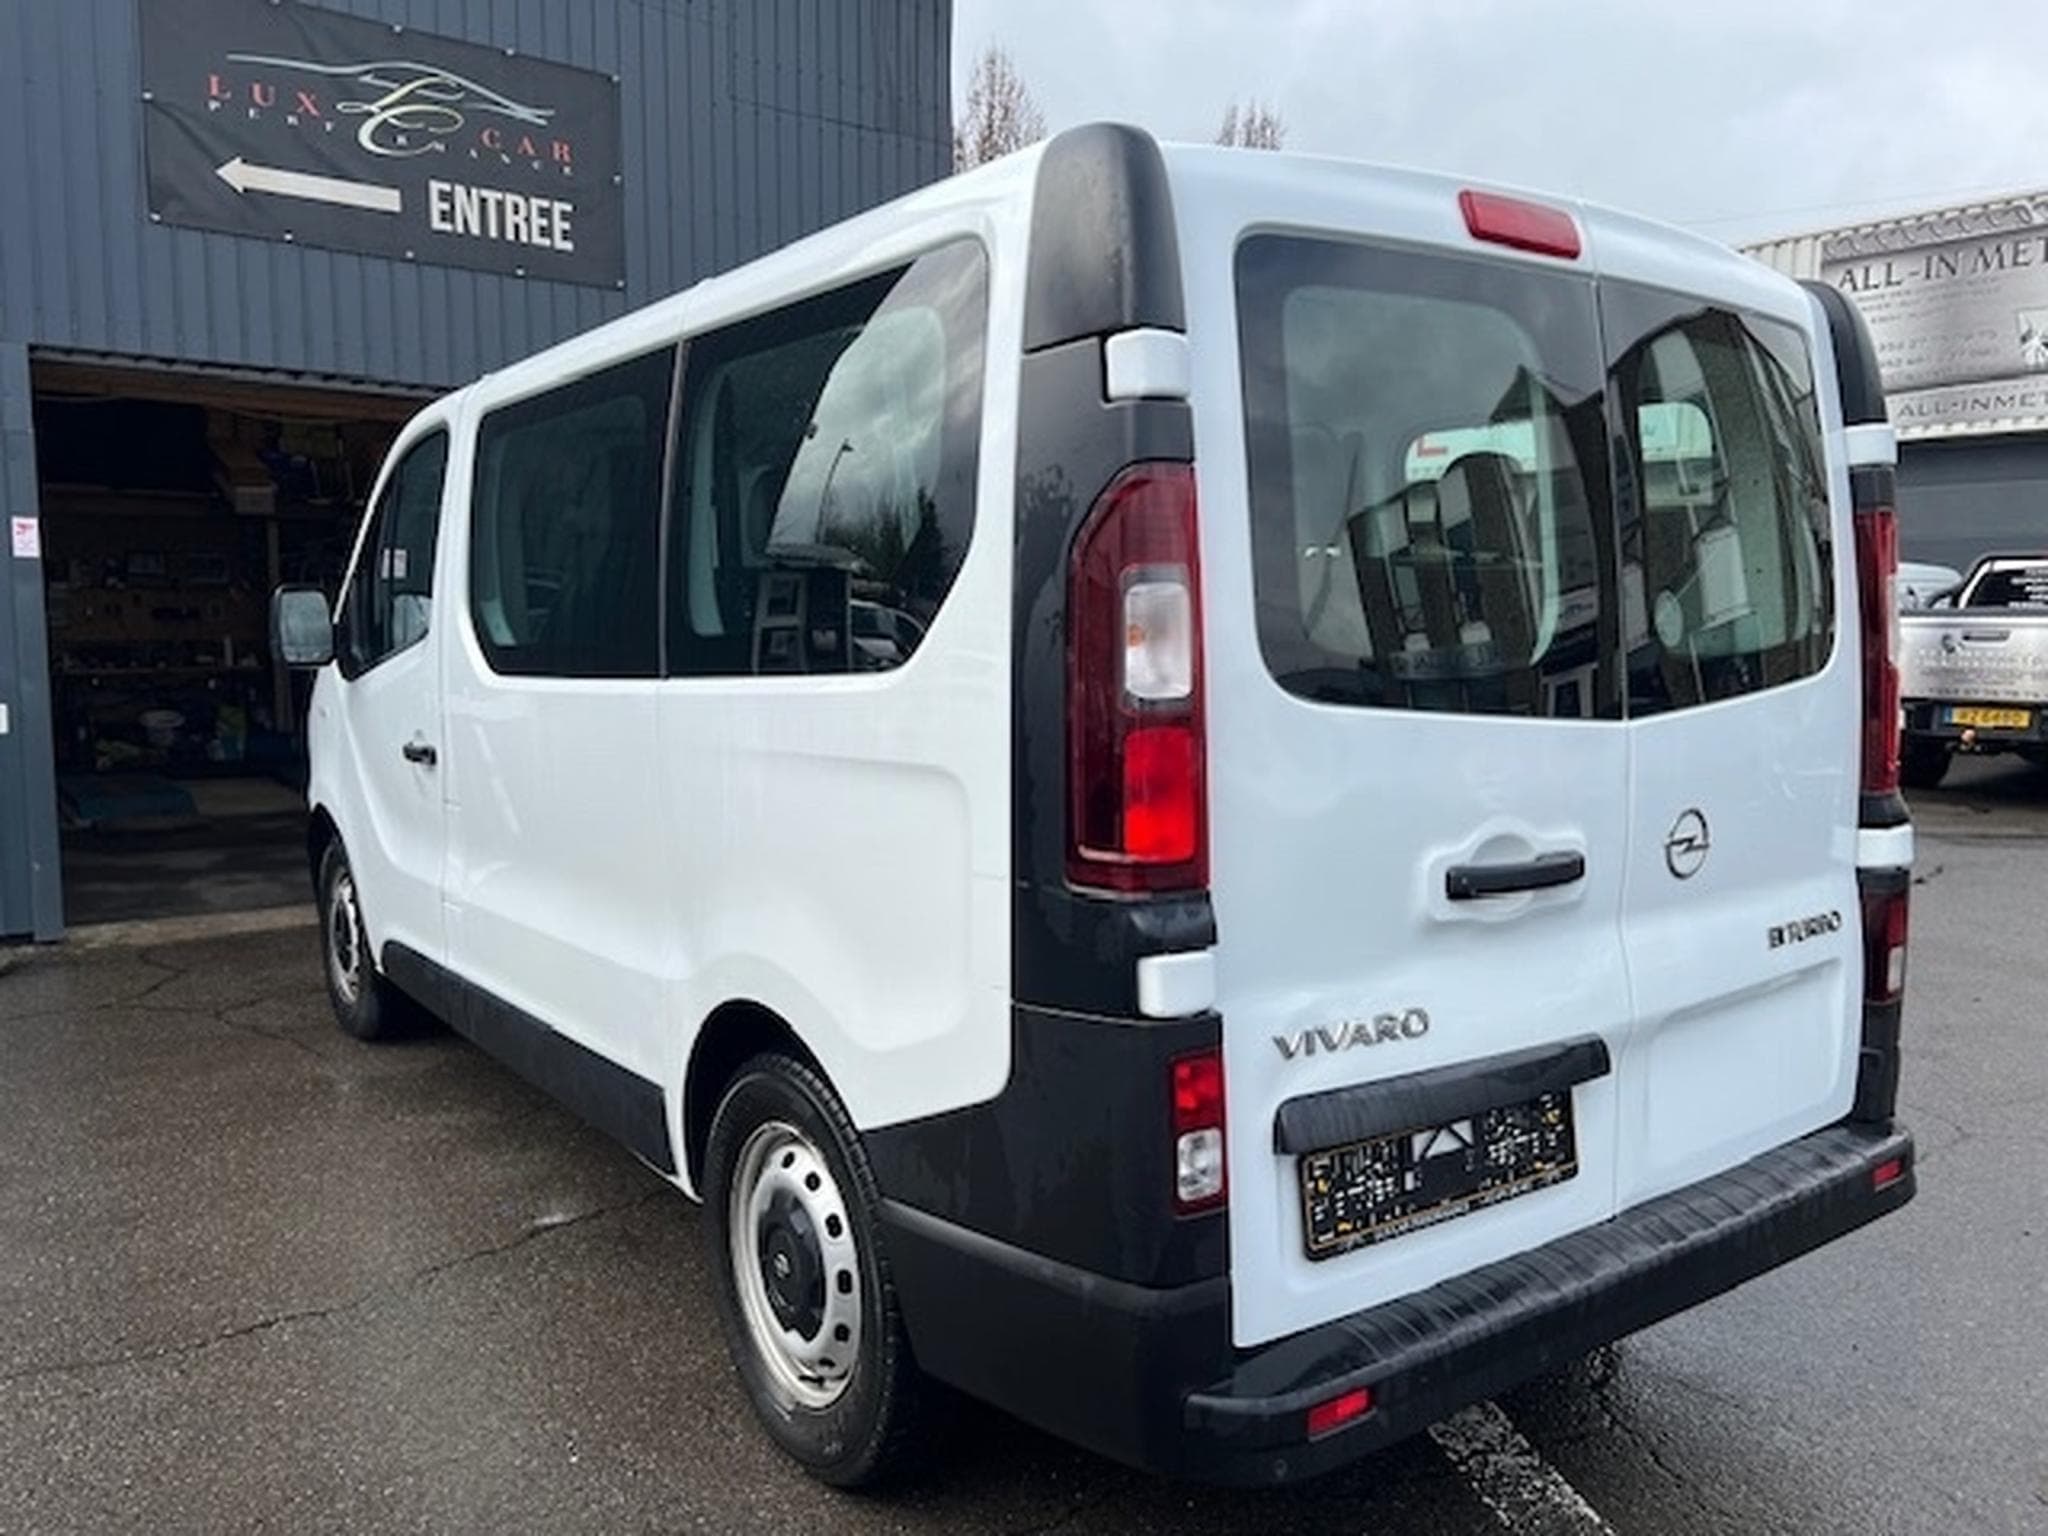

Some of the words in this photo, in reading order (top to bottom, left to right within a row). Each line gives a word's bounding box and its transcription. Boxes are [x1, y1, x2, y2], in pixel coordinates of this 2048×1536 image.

[208, 74, 321, 117] LUX
[482, 128, 573, 163] CAR
[428, 179, 574, 252] ENTREE
[1273, 1007, 1430, 1061] VIVARO
